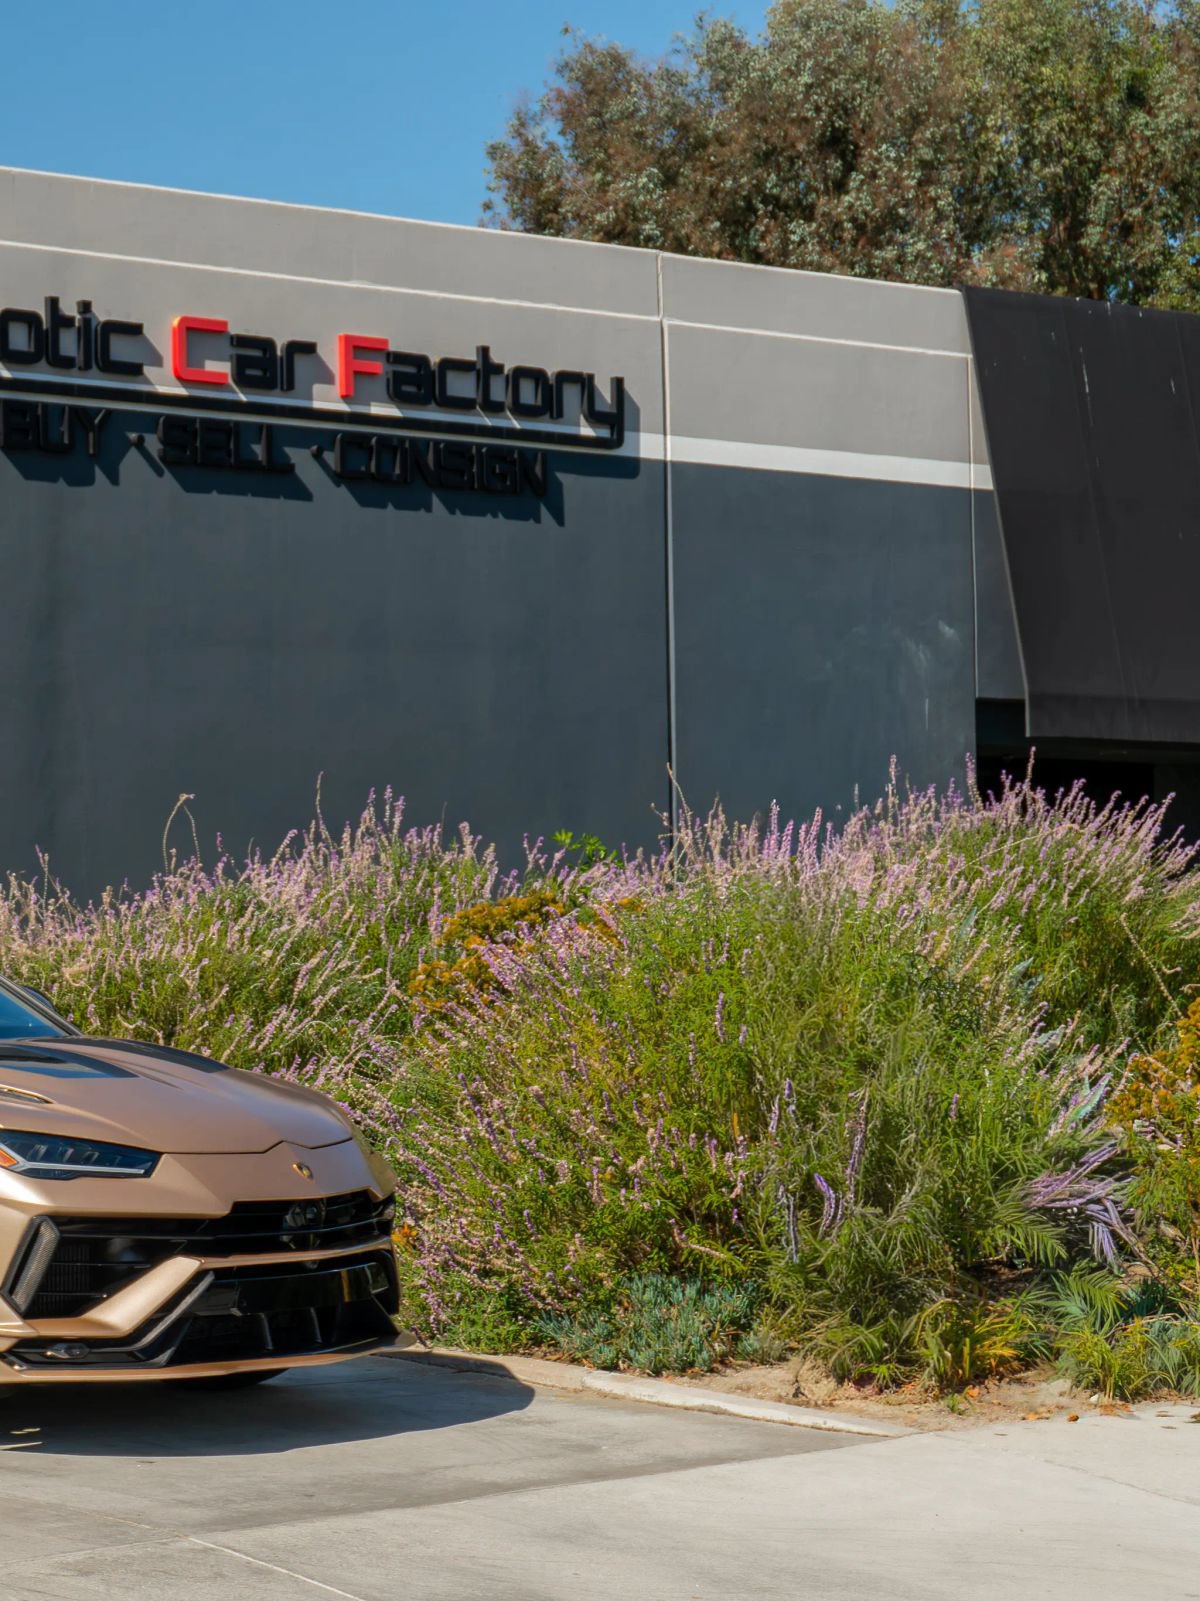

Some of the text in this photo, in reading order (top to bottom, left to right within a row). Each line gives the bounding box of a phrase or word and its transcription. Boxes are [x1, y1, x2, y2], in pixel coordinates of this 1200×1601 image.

[171, 315, 318, 392] Car
[337, 333, 625, 447] Factory
[156, 414, 296, 474] SELL
[333, 431, 549, 498] CONSIGN
